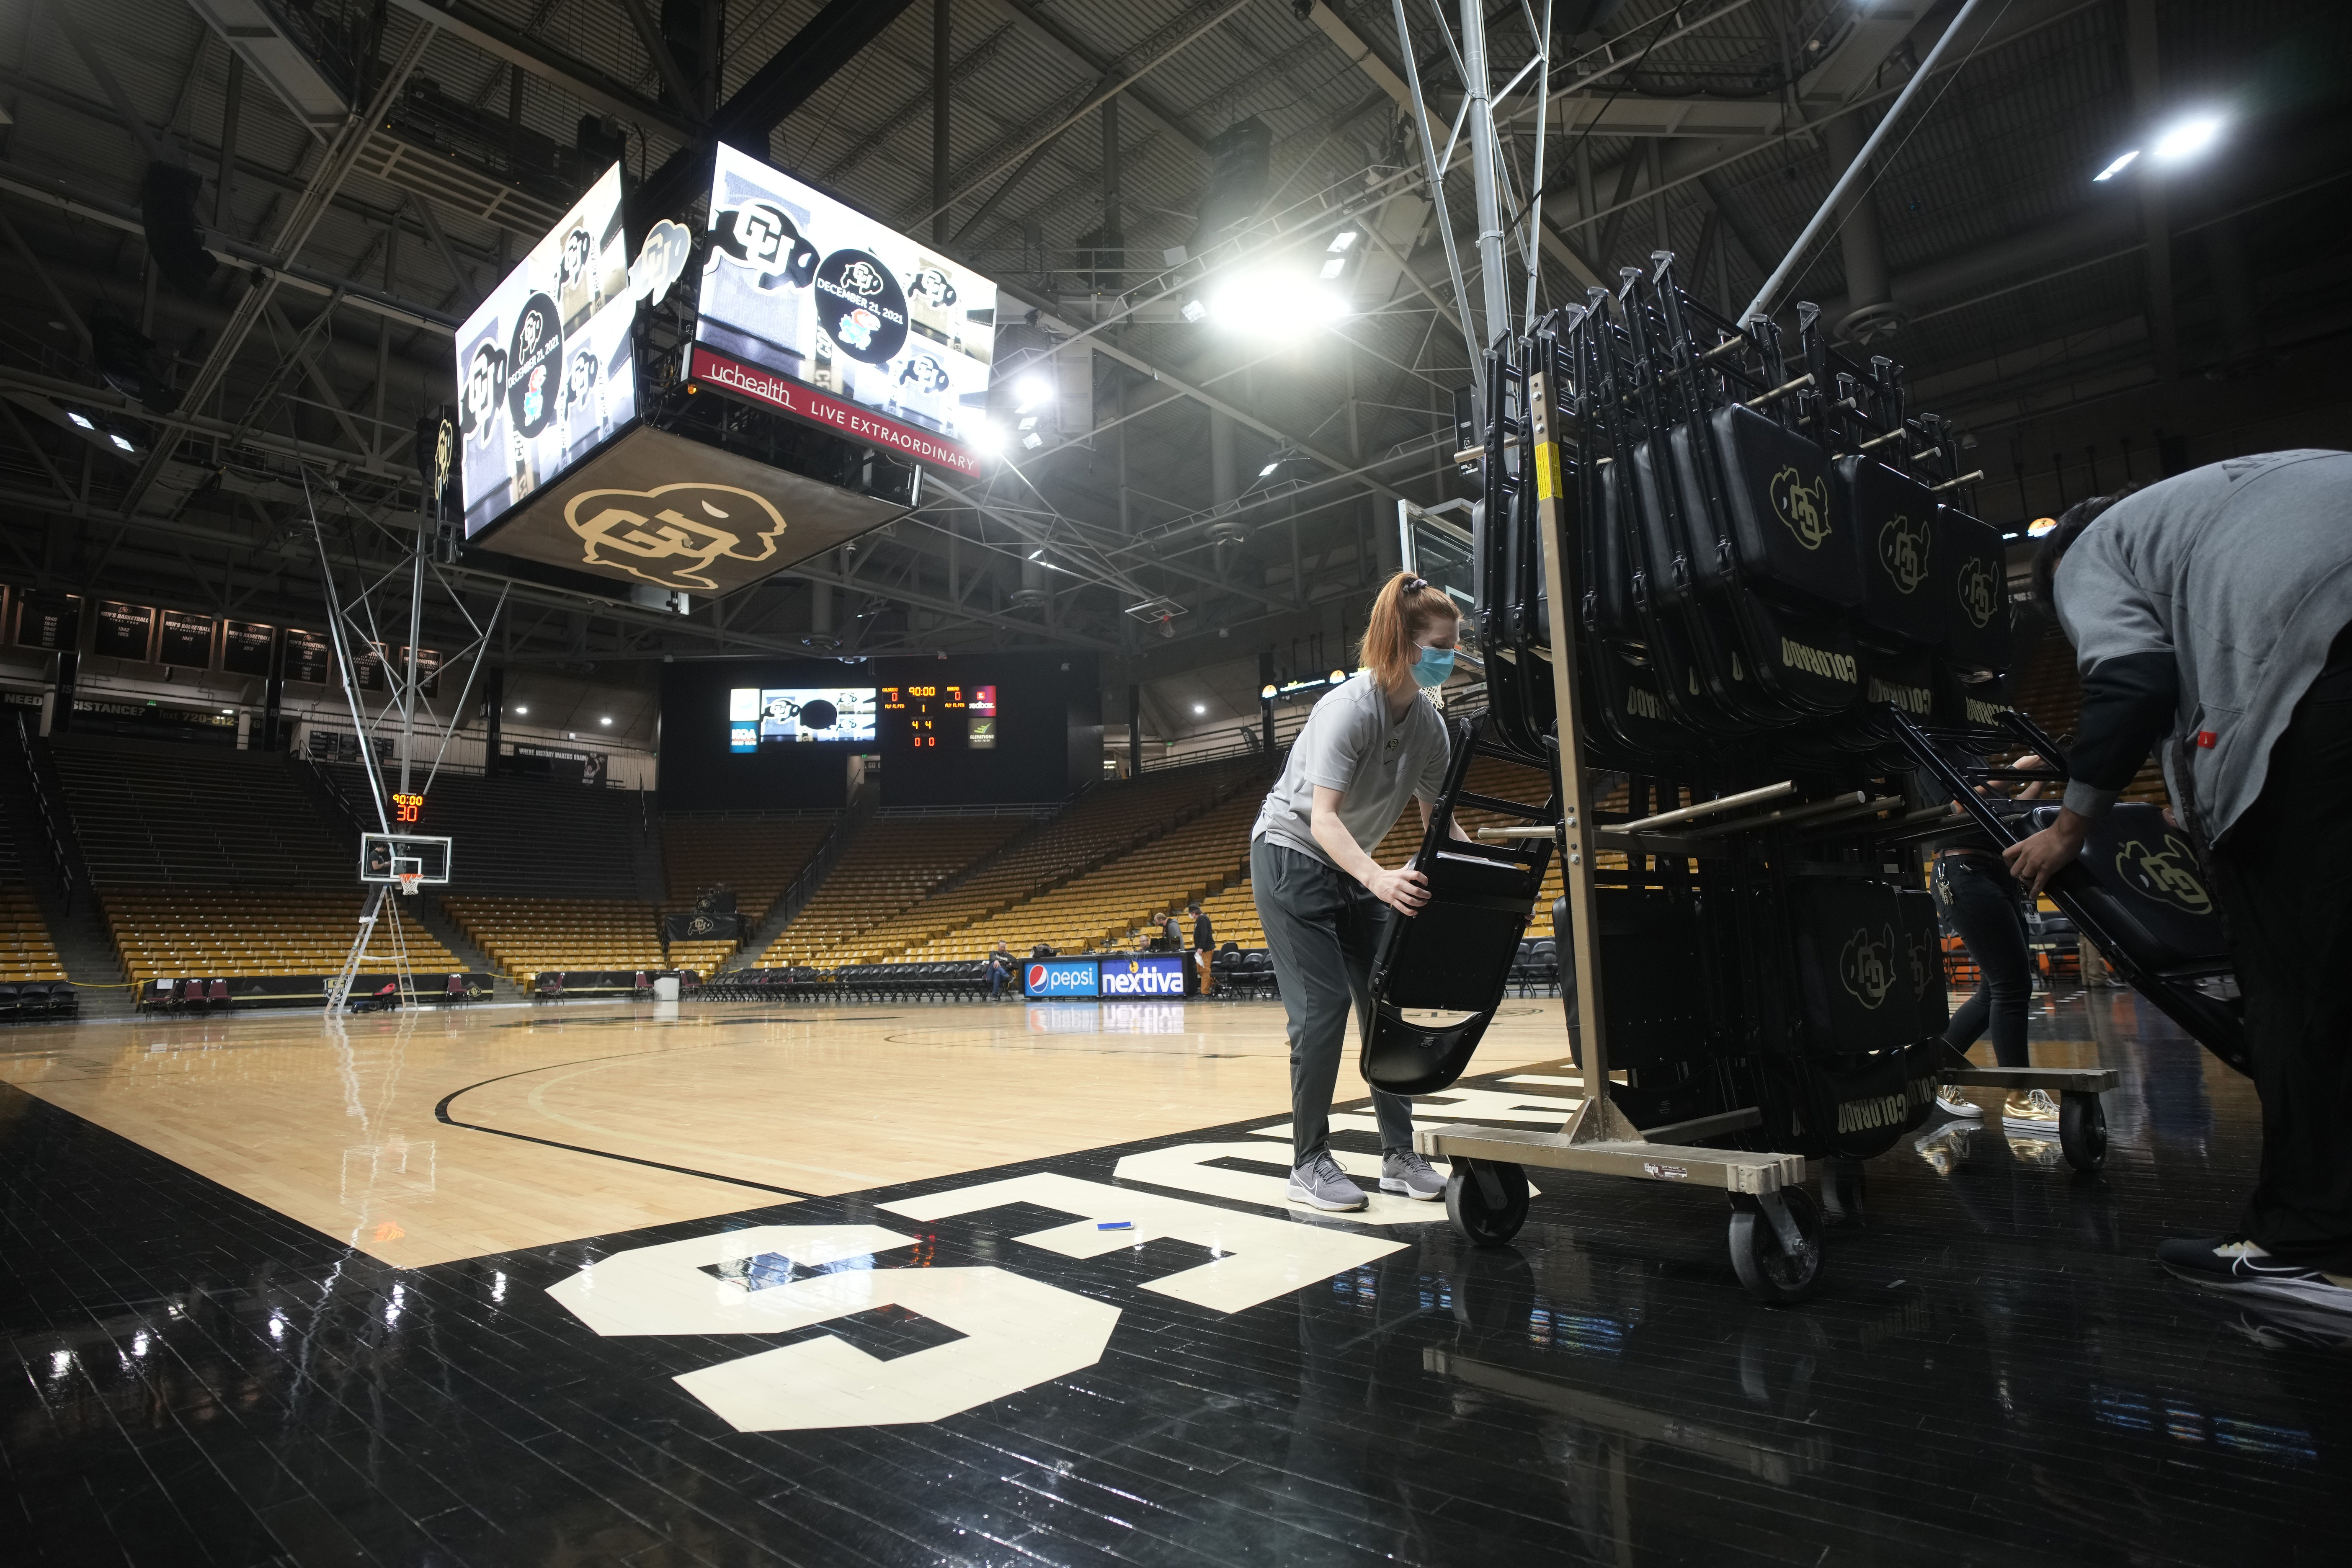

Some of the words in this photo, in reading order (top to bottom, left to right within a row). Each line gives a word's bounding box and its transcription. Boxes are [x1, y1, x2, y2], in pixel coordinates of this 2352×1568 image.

[733, 208, 795, 277] CU
[817, 277, 868, 309] DECEMBER
[868, 301, 881, 315] 21,
[882, 308, 904, 325] 2021
[508, 355, 537, 389] DECEMBER
[536, 348, 545, 363] 21,
[545, 334, 560, 356] 2021
[712, 363, 790, 405] uchealth
[811, 400, 845, 425] LIVE
[851, 418, 975, 471] EXTRAORDINARY
[579, 508, 741, 558] CU
[117, 614, 149, 623] BASKETBALL
[181, 623, 211, 632] BASKETBALL
[243, 632, 271, 642] BASKETBALL
[1781, 636, 1857, 684] COLORADO
[61, 684, 73, 694] 15
[909, 686, 936, 696] 90:00
[1867, 674, 1932, 715] COLORADO
[4, 693, 43, 706] NEED
[891, 692, 898, 702] 0
[954, 691, 961, 701] 0
[158, 709, 179, 720] Text
[268, 708, 279, 717] 15
[912, 720, 919, 730] 4
[925, 720, 932, 729] 4
[731, 728, 757, 739] KOA
[914, 737, 921, 747] 0
[928, 737, 935, 747] 0
[518, 747, 535, 756] WHERE
[535, 749, 554, 758] HISTORY
[554, 752, 573, 760] MAKERS
[392, 794, 423, 806] 90:00
[397, 804, 418, 822] 30
[1051, 967, 1093, 990] pepsi
[1102, 966, 1184, 993] nextiva
[1838, 1093, 1906, 1135] COLORADO
